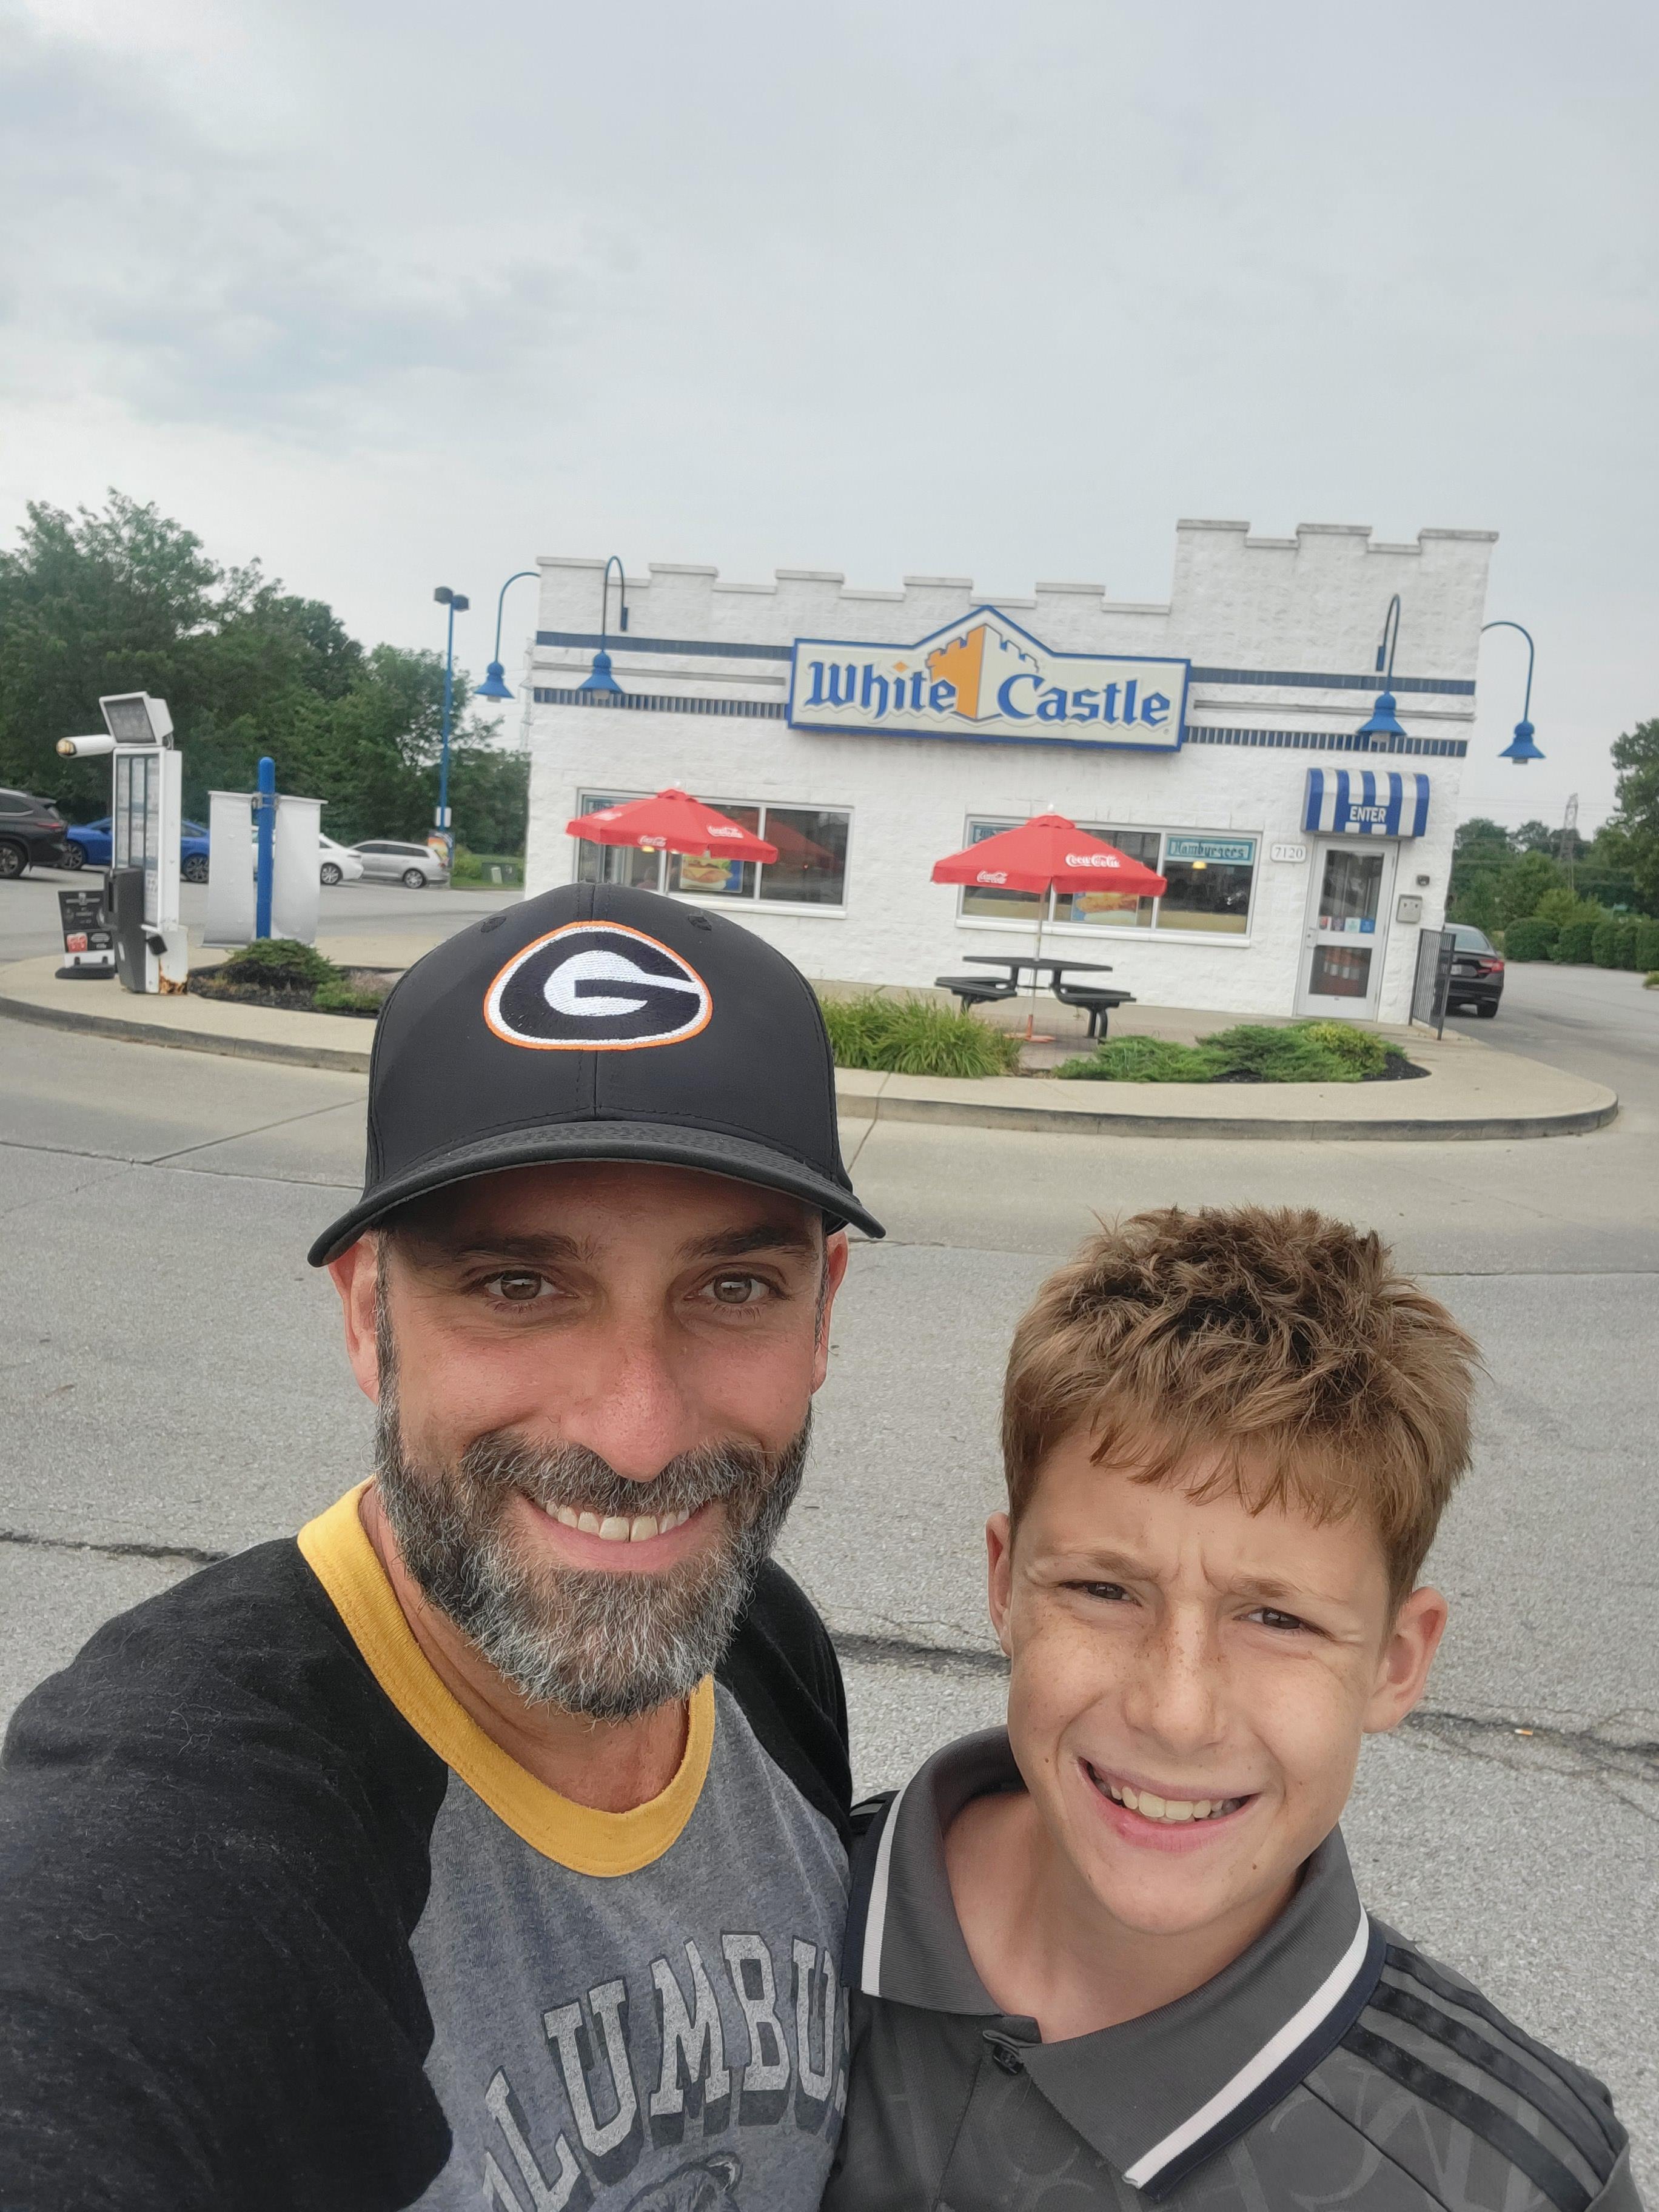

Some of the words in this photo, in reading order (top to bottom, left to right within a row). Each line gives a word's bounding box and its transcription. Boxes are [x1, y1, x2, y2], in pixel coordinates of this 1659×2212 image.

[804, 661, 956, 720] White
[997, 673, 1170, 726] Castle
[1350, 805, 1386, 822] ENTER
[1065, 853, 1121, 868] Coca-Cola
[1275, 846, 1303, 860] 7120
[483, 1931, 850, 2212] LUMBU
